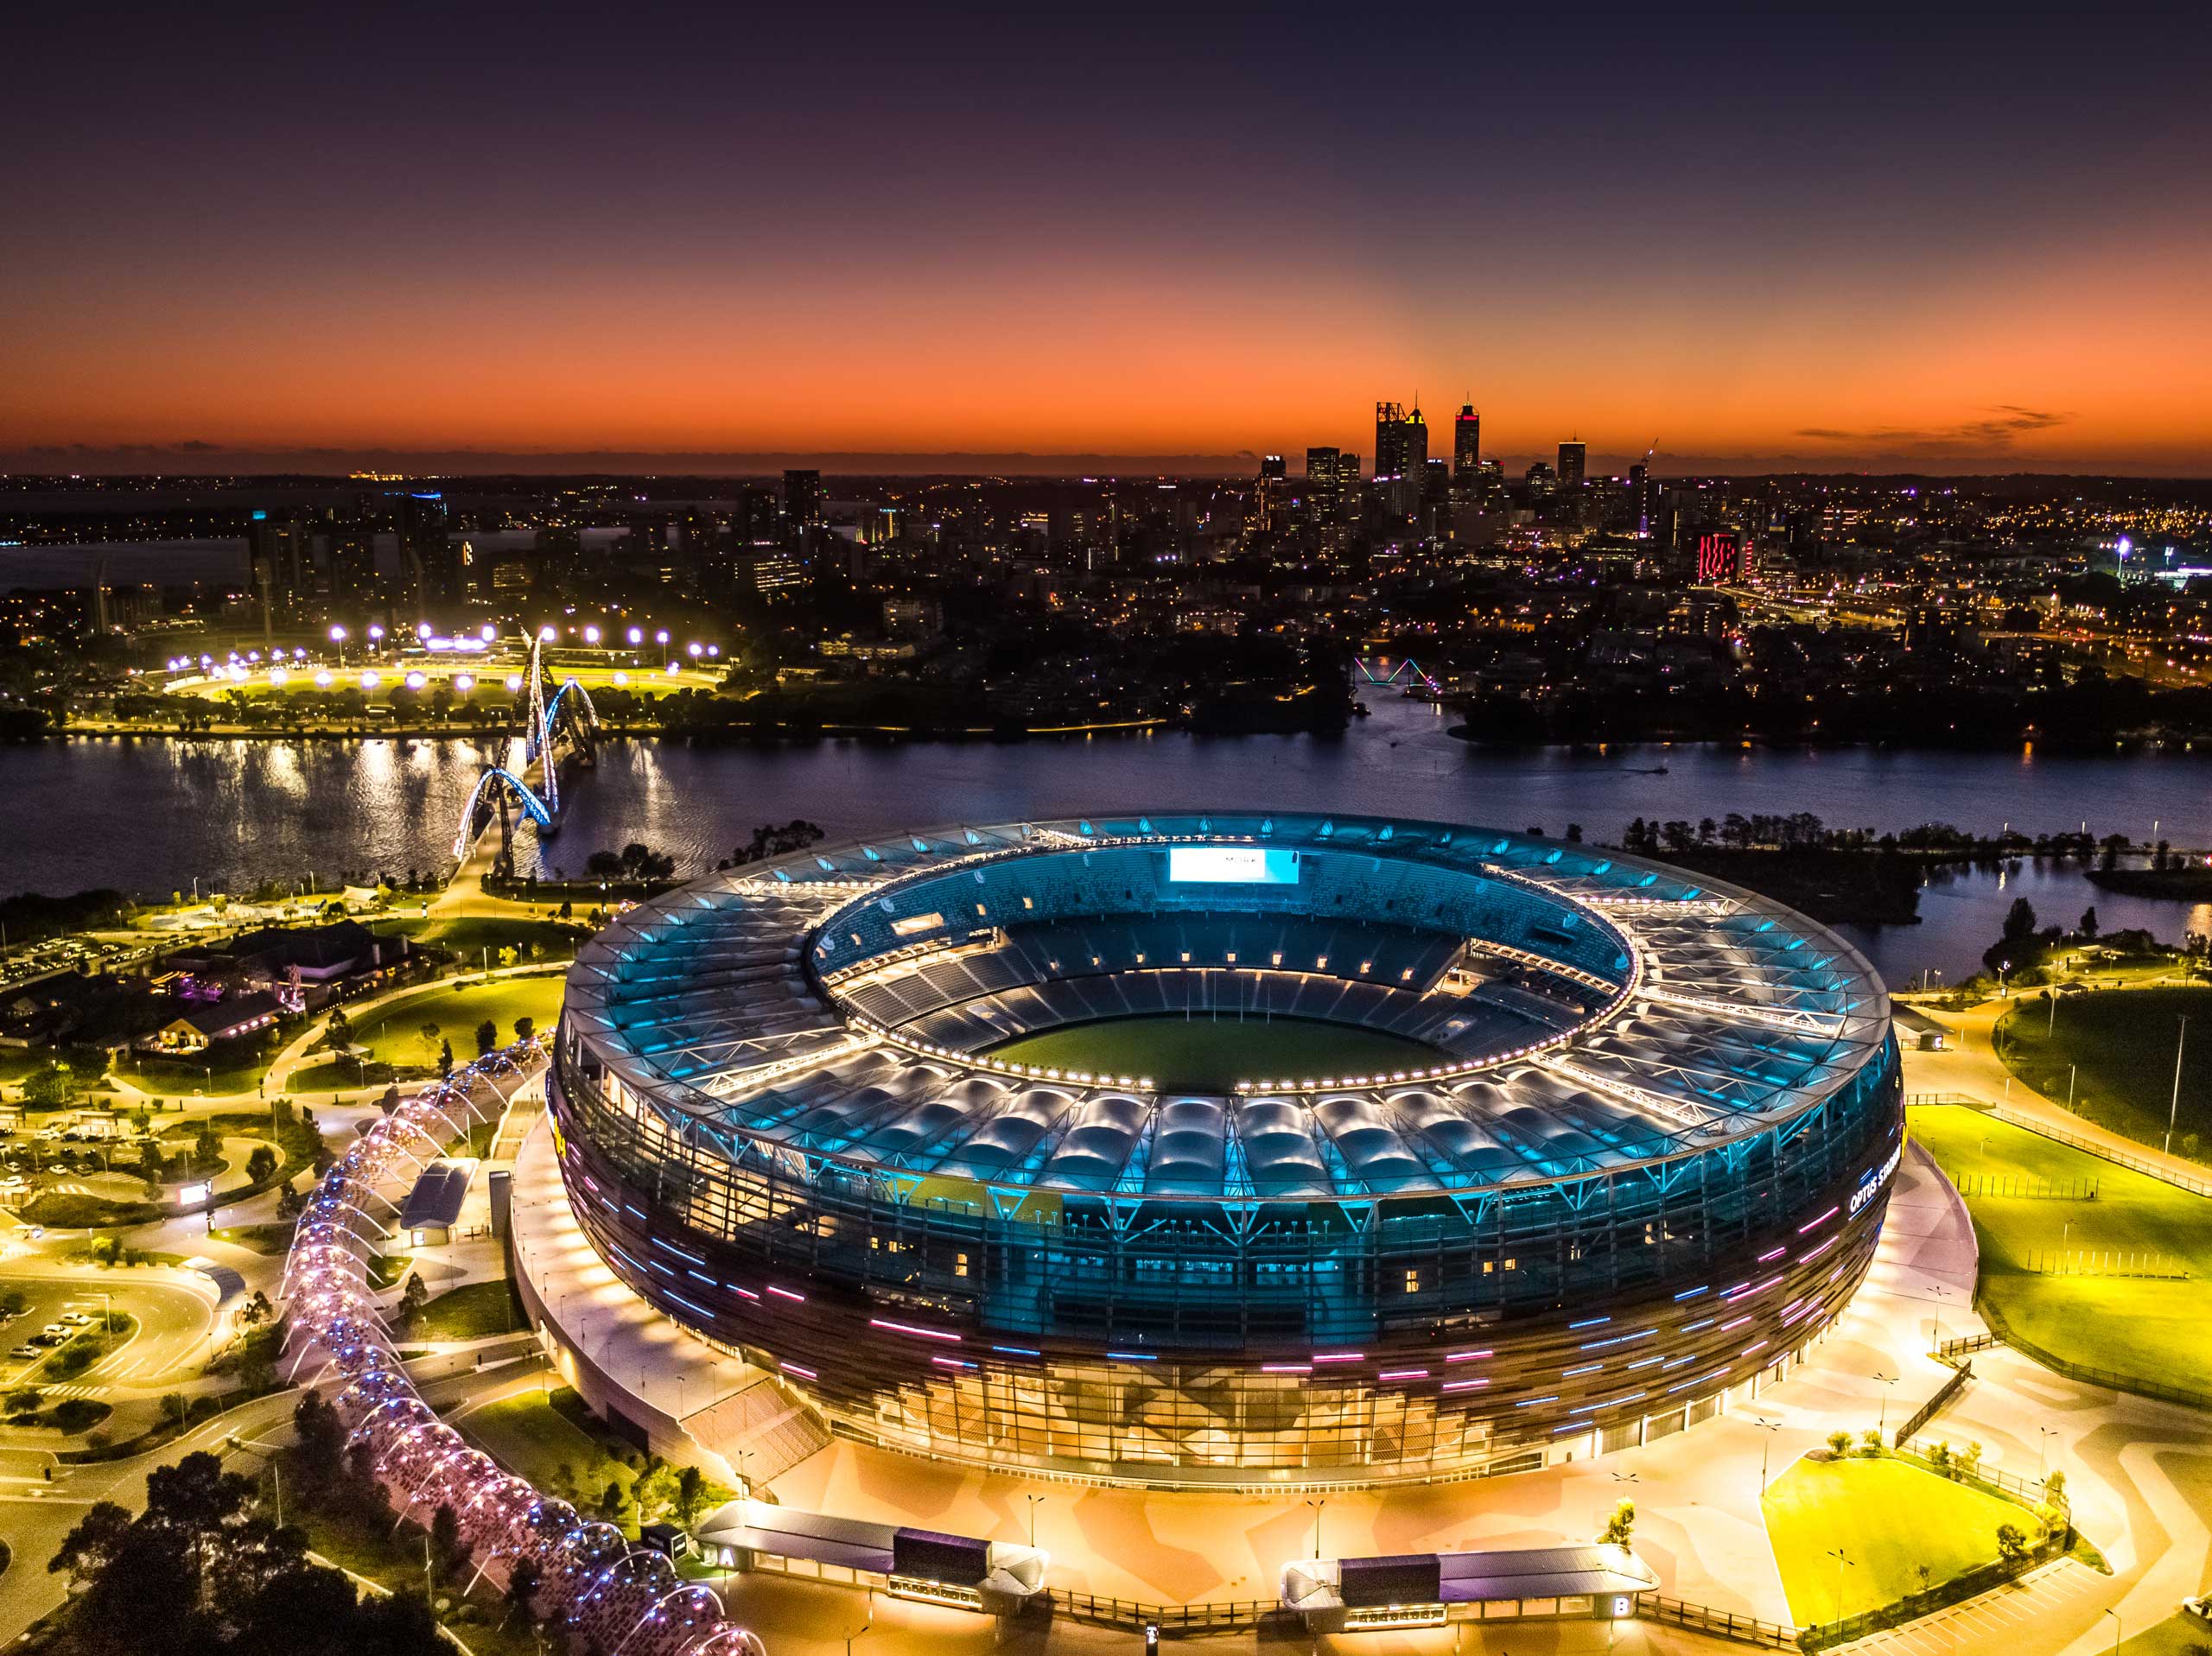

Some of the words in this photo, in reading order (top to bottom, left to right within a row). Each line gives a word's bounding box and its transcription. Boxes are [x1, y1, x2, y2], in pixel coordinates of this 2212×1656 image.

[1850, 1176, 1878, 1213] OPTUS
[1878, 1143, 1901, 1187] STADIUM
[1614, 1597, 1629, 1616] B
